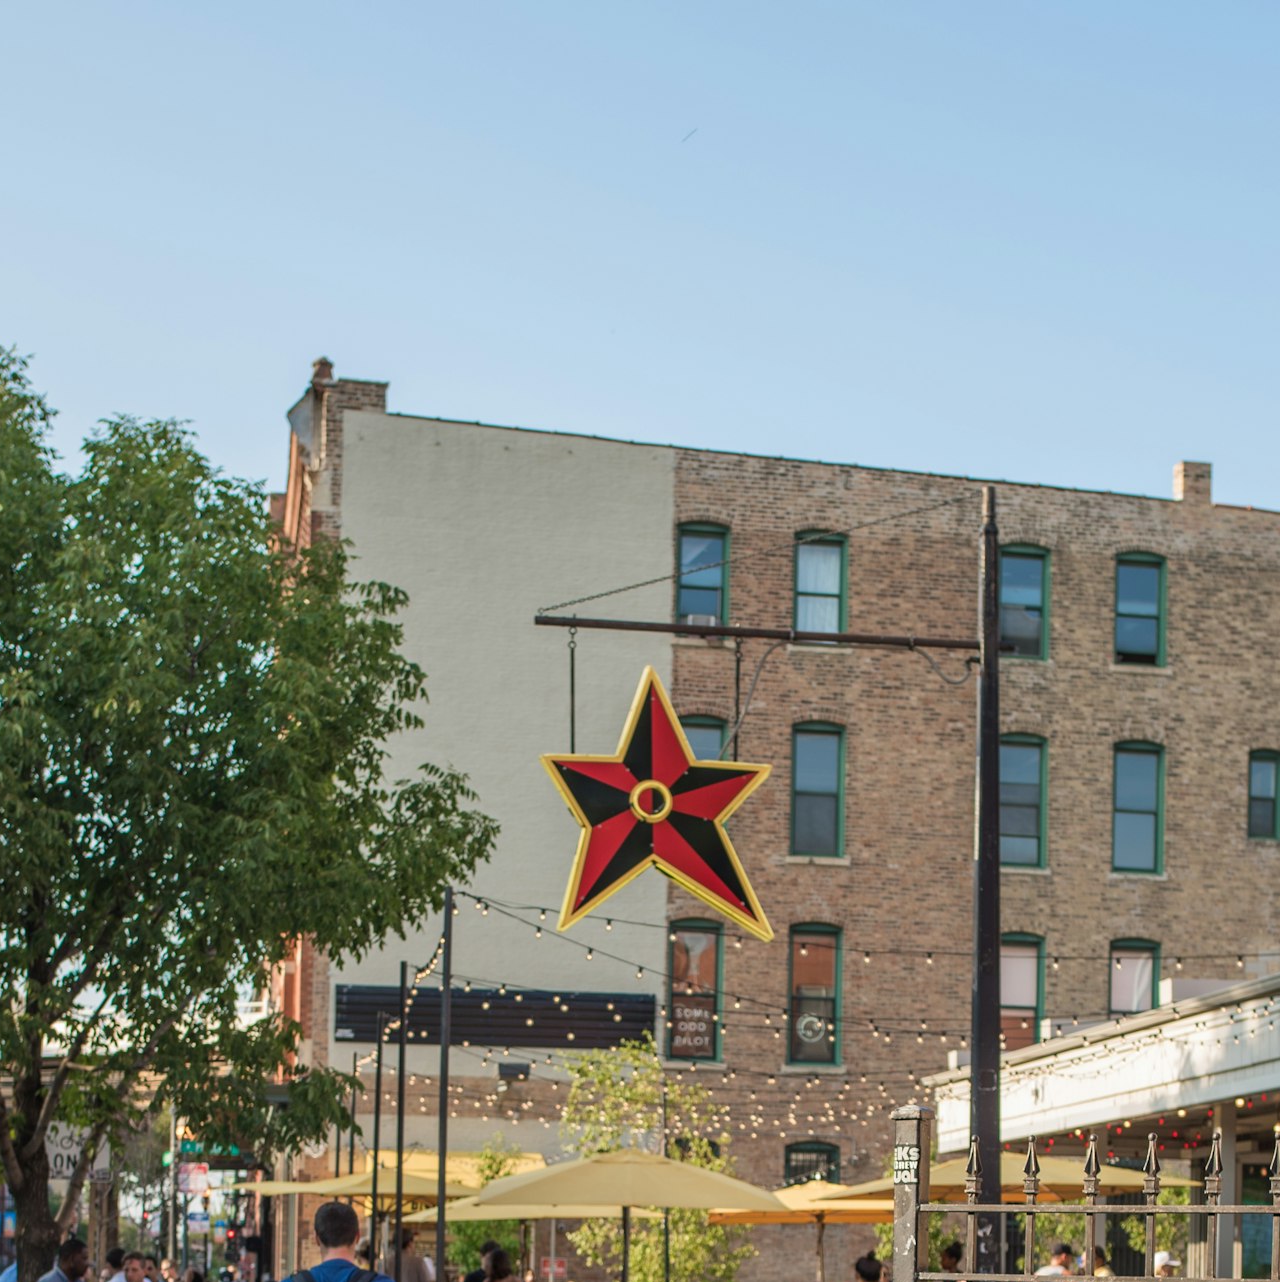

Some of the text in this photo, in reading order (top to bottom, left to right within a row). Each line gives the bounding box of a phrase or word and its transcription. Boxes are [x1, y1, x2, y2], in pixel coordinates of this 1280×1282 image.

[675, 1007, 710, 1019] SOME
[678, 1021, 707, 1032] ODD
[673, 1035, 710, 1047] PILOT
